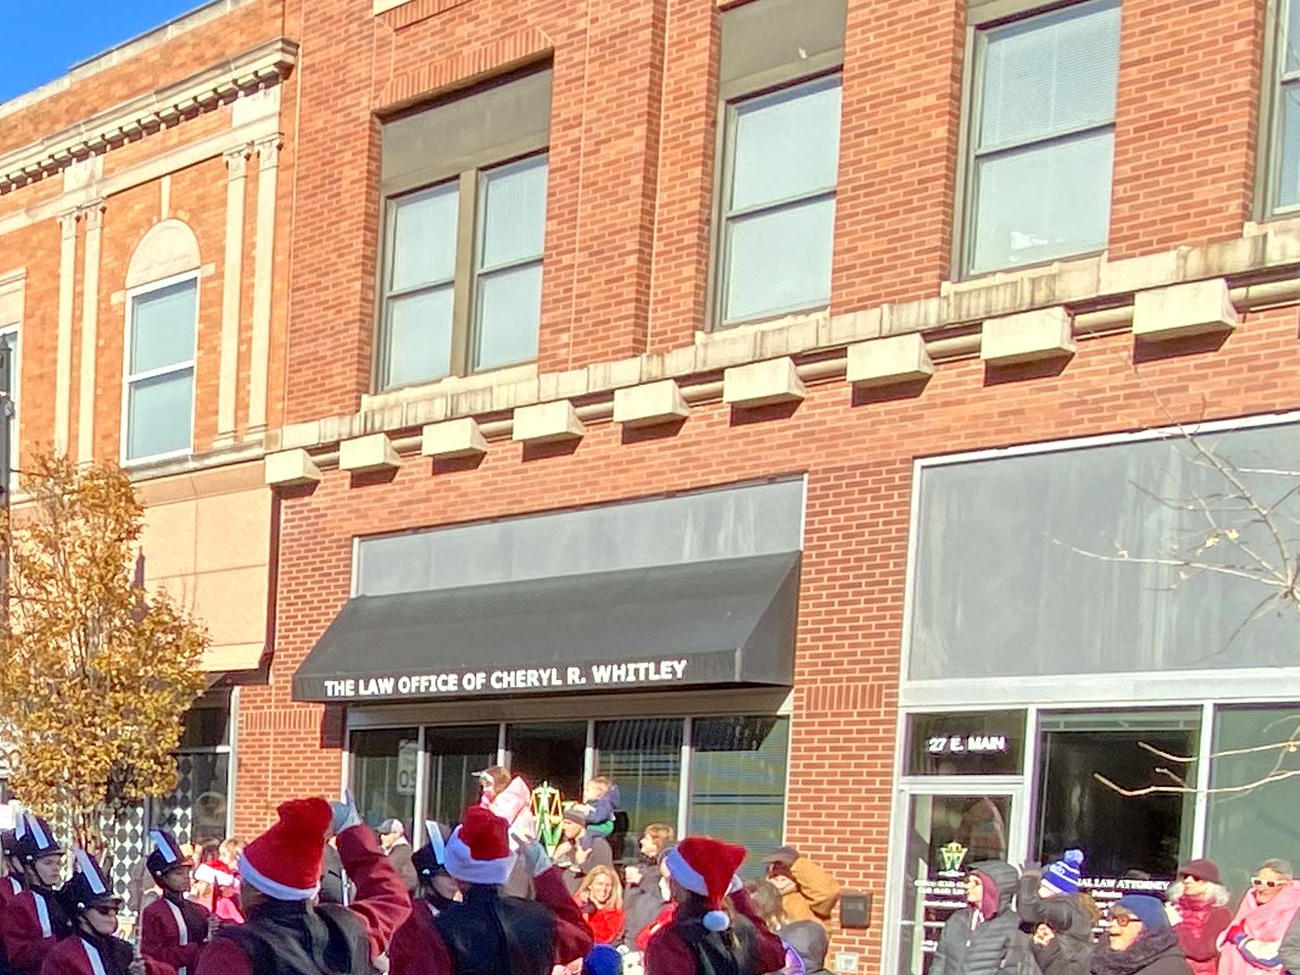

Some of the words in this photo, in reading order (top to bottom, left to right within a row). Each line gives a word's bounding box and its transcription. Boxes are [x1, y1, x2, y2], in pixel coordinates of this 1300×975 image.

[324, 679, 355, 697] THE
[358, 677, 395, 696] LAW
[398, 673, 459, 694] OFFICE
[462, 672, 486, 691] OF
[490, 668, 562, 689] CHERYL
[567, 667, 587, 685] R.
[592, 660, 687, 683] WHITLEY
[927, 736, 948, 752] 27
[950, 736, 965, 752] E.
[967, 735, 1006, 751] MAIN
[1117, 879, 1171, 891] ATTORNEY
